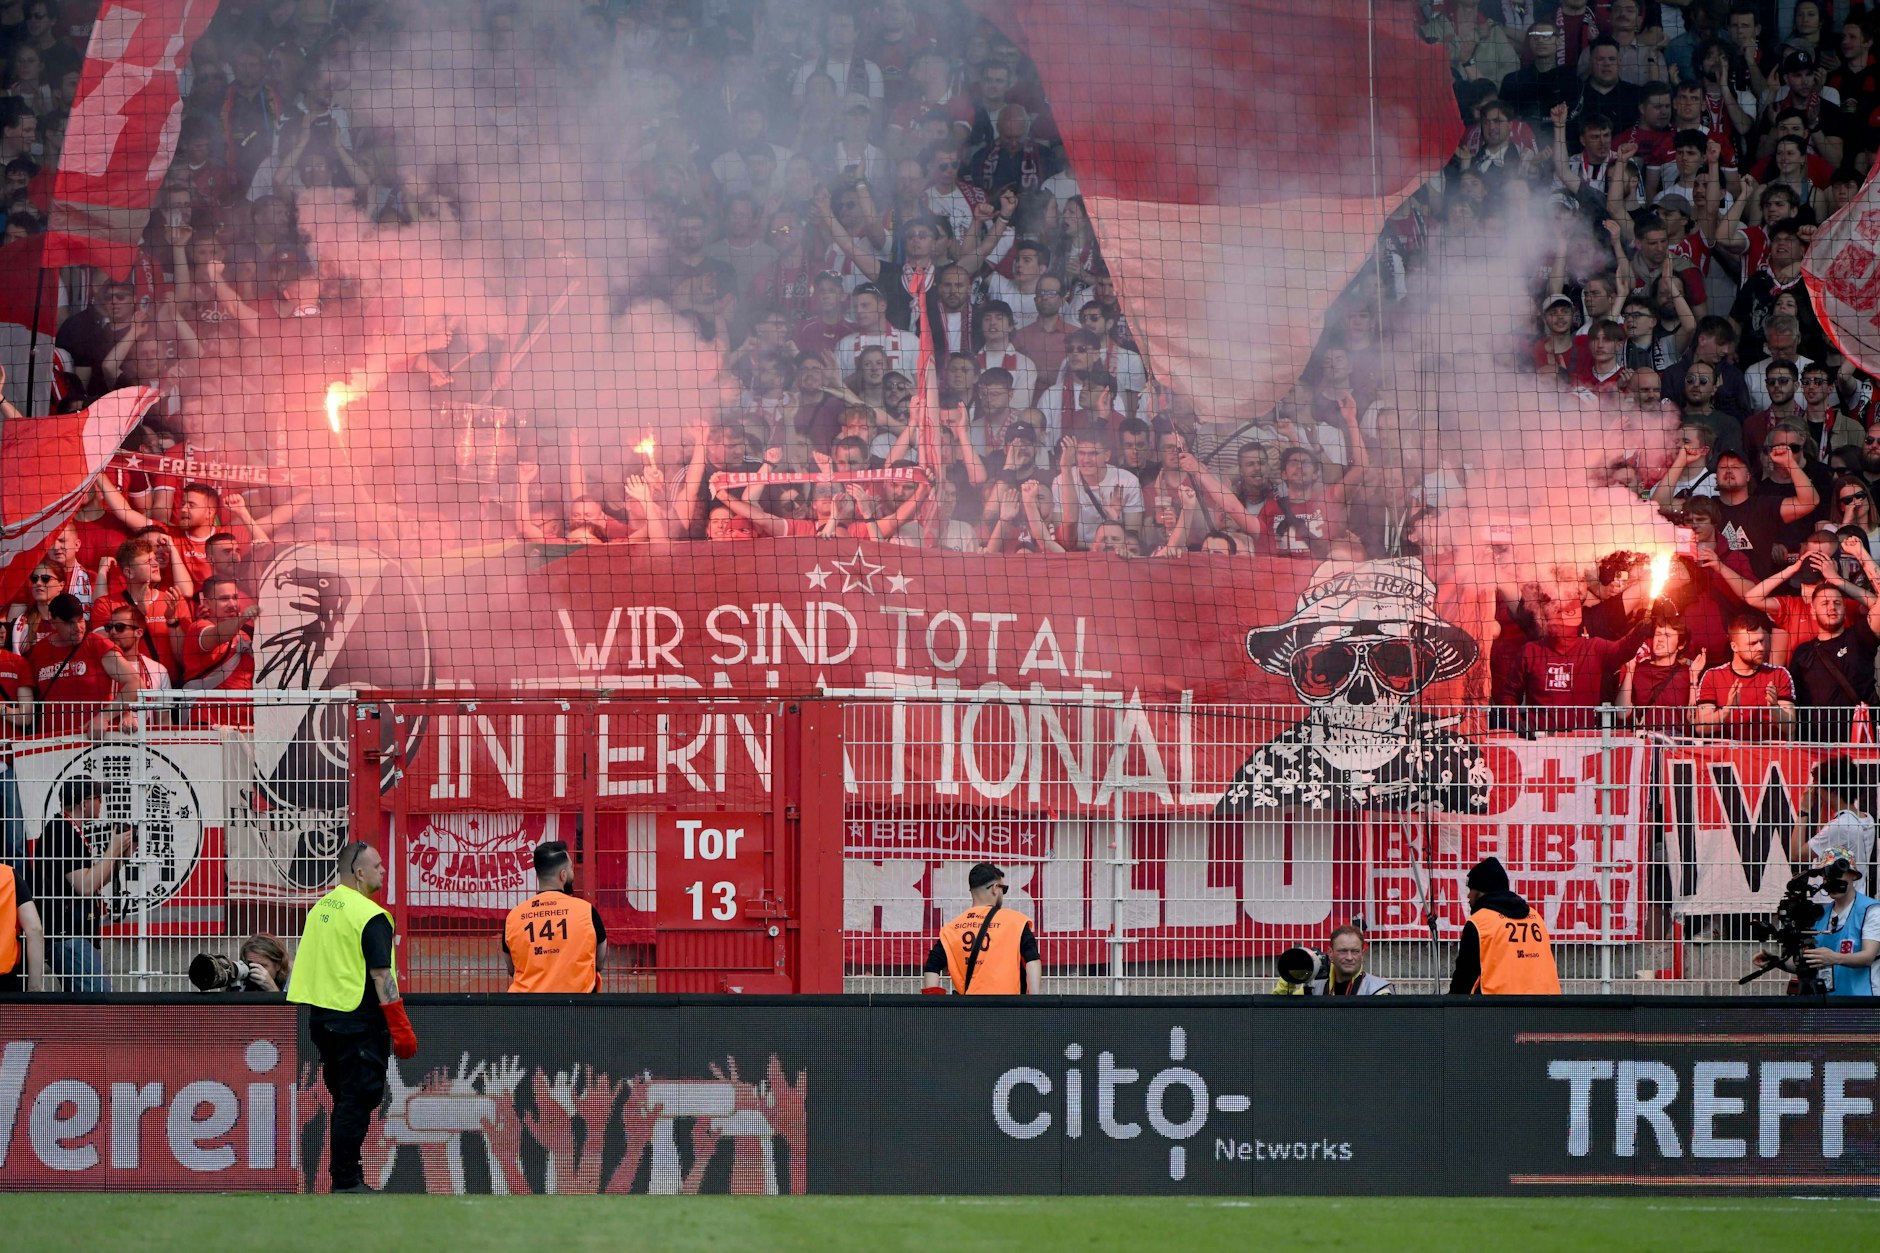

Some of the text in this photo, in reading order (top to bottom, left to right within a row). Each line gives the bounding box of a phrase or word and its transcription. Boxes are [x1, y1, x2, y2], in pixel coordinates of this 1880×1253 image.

[159, 457, 267, 482] FREIBURG
[1303, 575, 1361, 607] FORZA
[558, 601, 1112, 679] WIR SIND TOTAL
[430, 671, 1228, 806] INTERNTIONAL
[676, 820, 744, 860] Tor
[874, 821, 1011, 845] BEI UNS
[410, 844, 534, 880] 10 JAHRE
[421, 872, 525, 894] CORRILLO ULTRAS
[520, 909, 569, 920] SICHERHEIT
[685, 881, 737, 921] 13
[1375, 876, 1631, 930] BATA!
[524, 919, 568, 942] 141
[962, 931, 990, 952] 90
[1505, 922, 1542, 942] 276
[1547, 1060, 1879, 1158] TREFF
[1215, 1138, 1353, 1160] Networks
